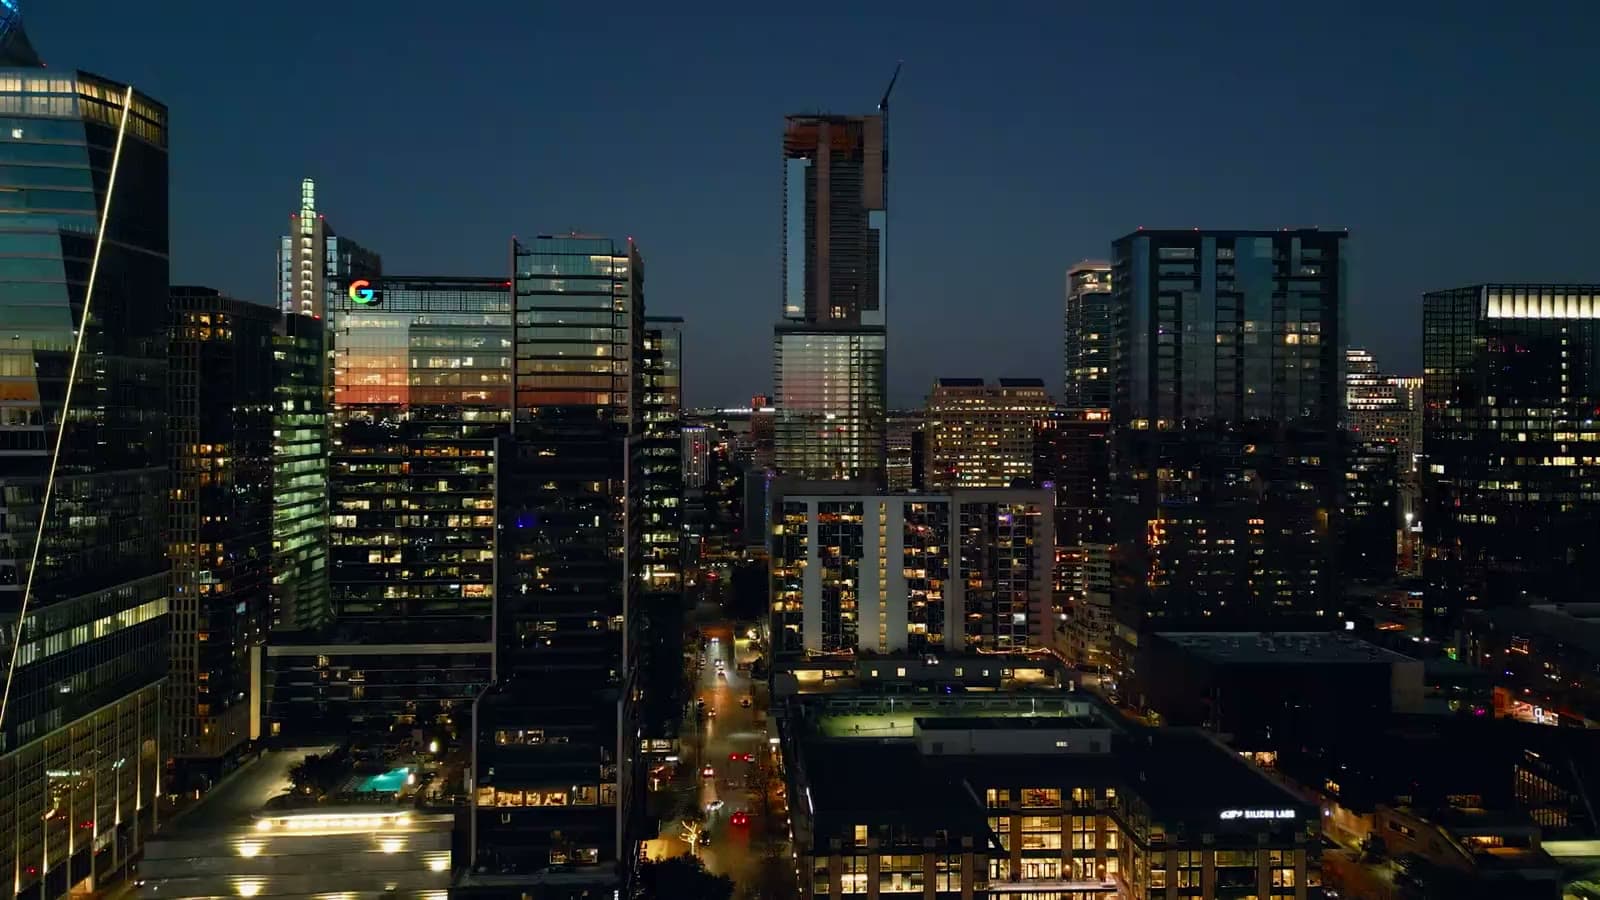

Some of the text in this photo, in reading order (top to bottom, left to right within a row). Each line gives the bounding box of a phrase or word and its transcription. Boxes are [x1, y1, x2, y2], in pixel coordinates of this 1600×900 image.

[349, 280, 373, 304] G
[1245, 809, 1295, 819] SILICON LABS
